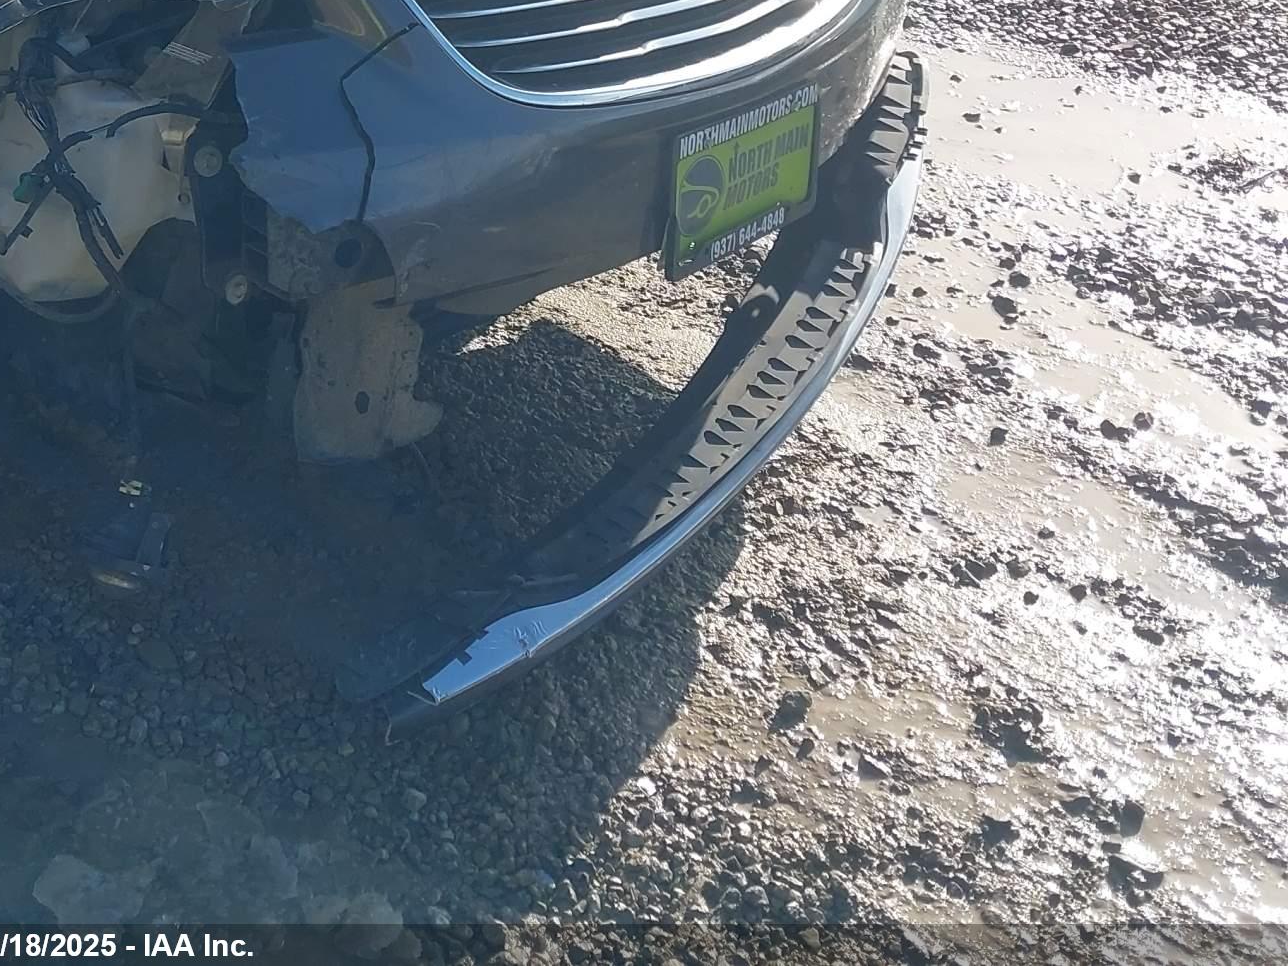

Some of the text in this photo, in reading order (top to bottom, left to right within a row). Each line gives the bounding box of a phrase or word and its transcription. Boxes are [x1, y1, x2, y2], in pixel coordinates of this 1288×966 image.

[679, 83, 818, 160] NORTHMAINMOTORSCOM
[728, 121, 810, 183] NORTH MAIN
[723, 162, 781, 211] MOTORS
[711, 206, 785, 260] (937) 644-4848
